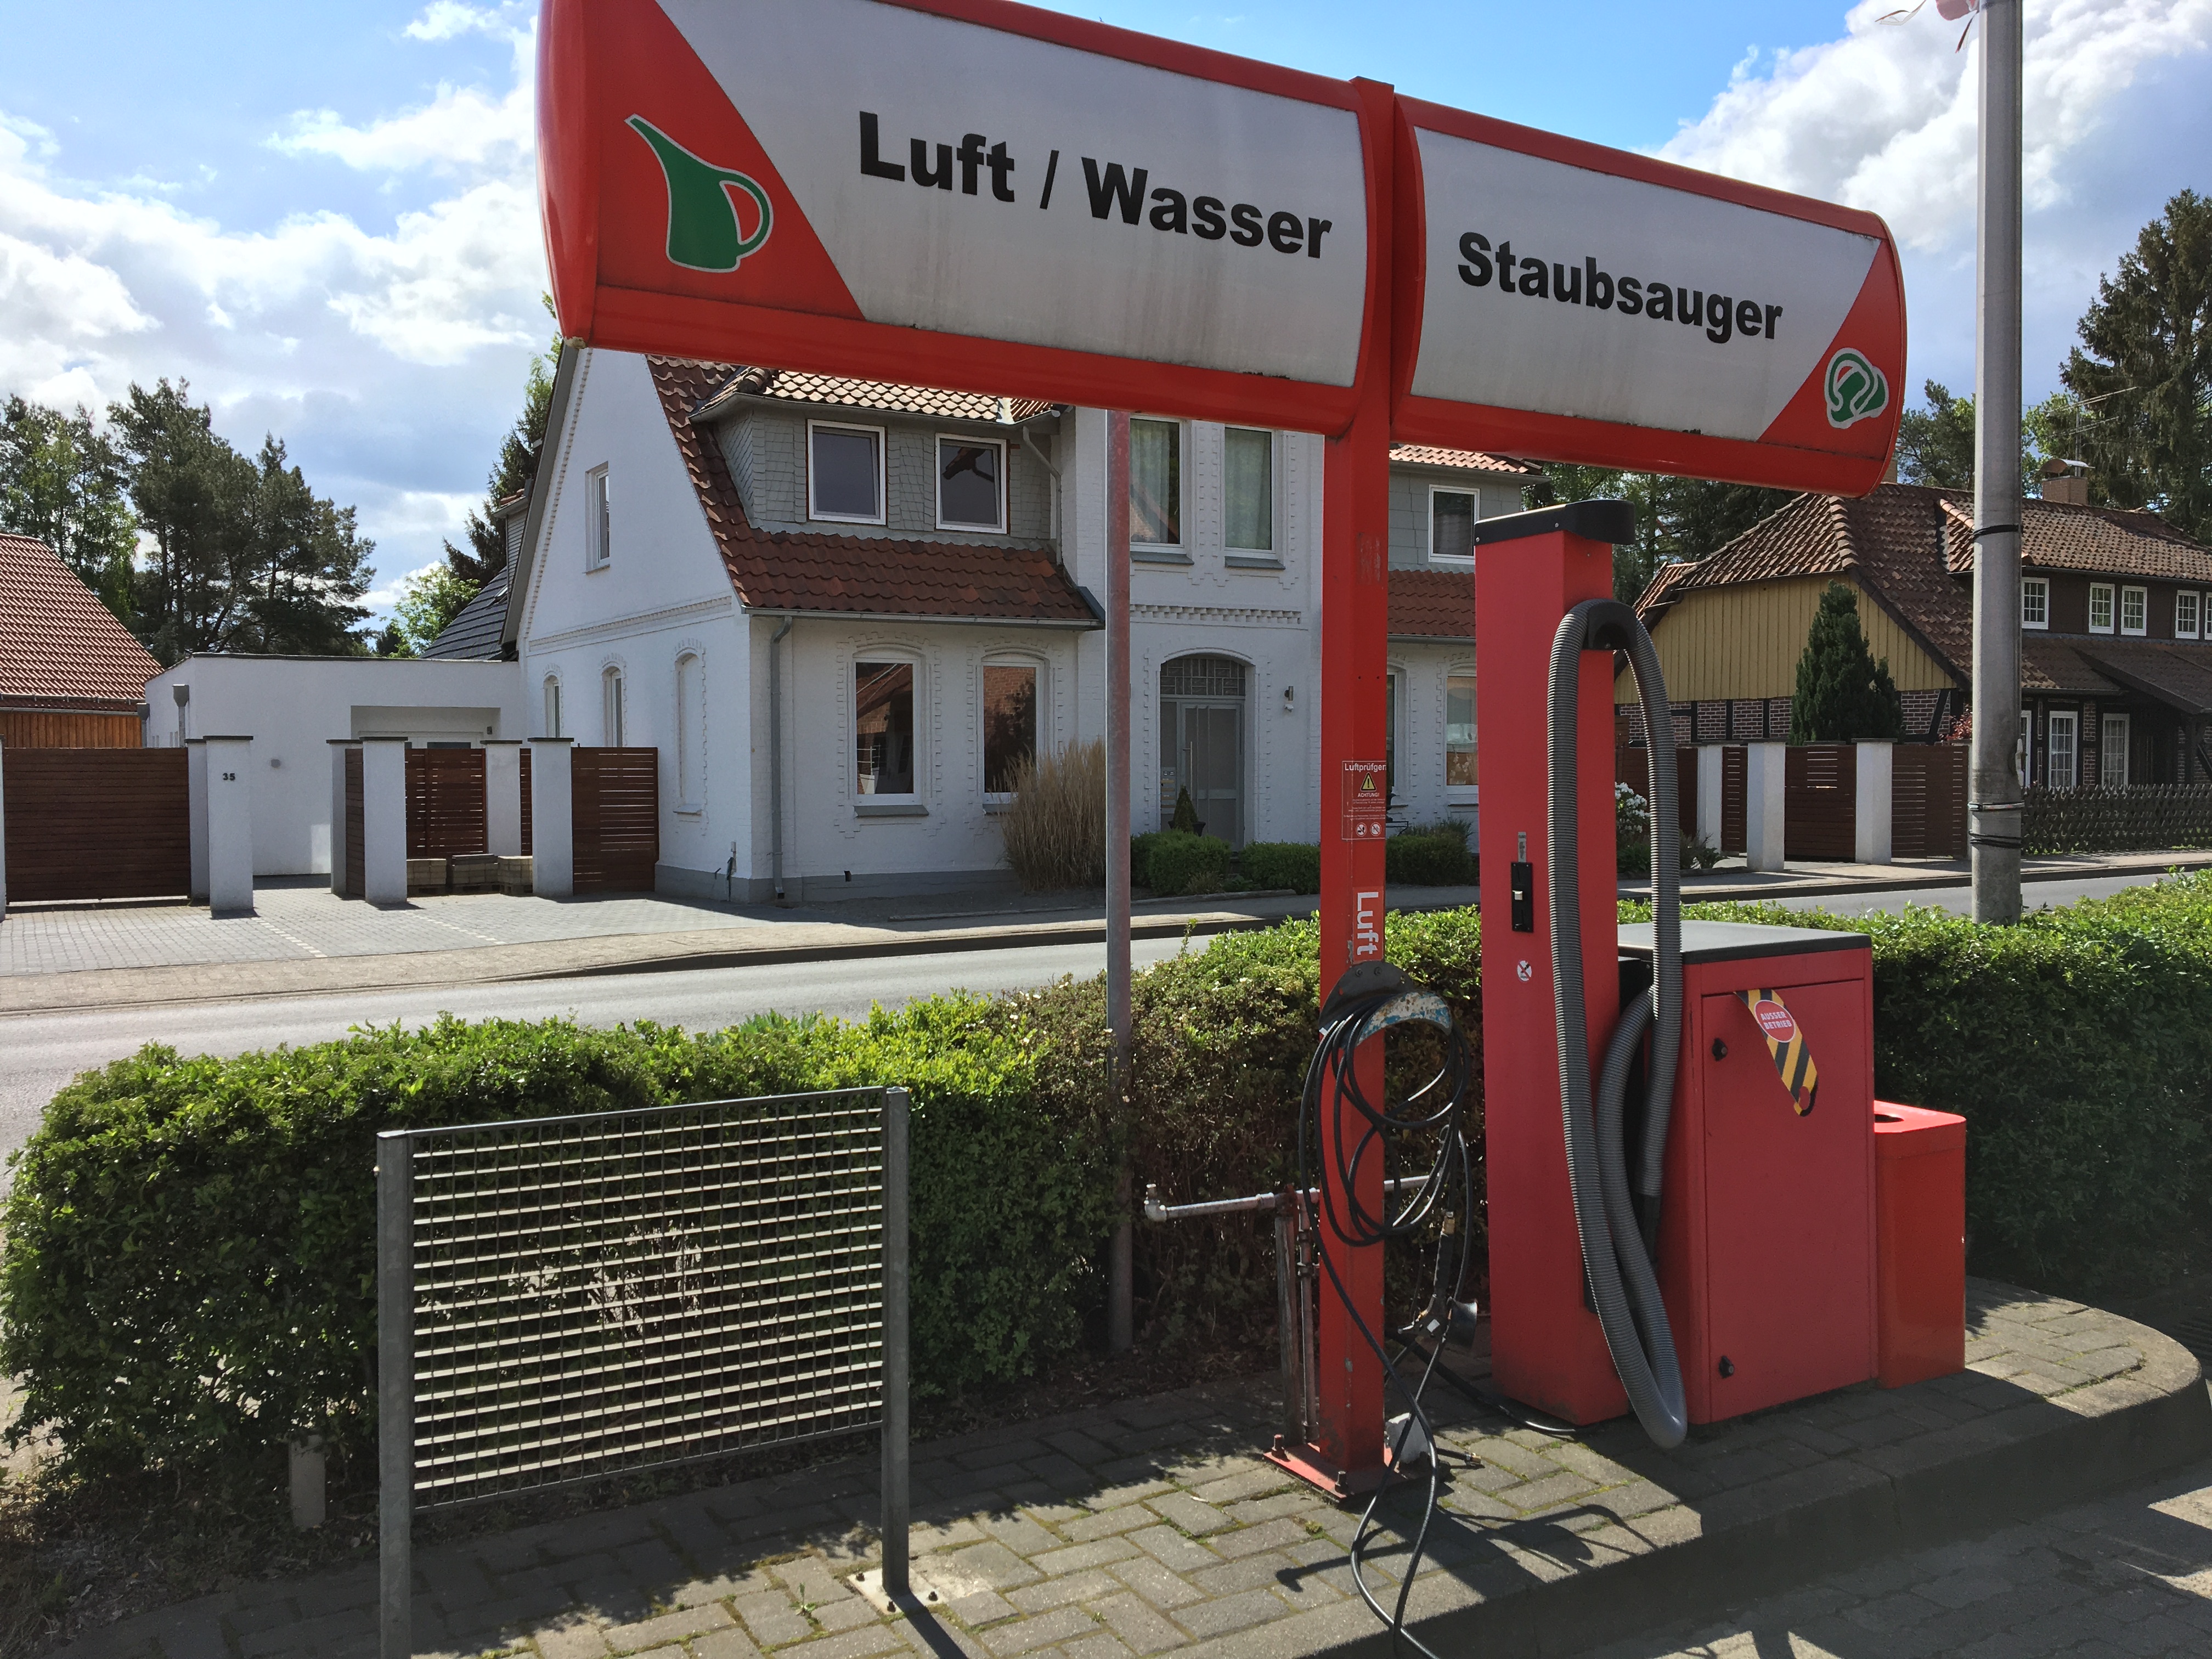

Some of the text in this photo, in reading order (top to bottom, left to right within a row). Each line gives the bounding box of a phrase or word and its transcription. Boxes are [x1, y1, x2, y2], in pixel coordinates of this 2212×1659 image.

[859, 110, 1333, 259] Luft / Wasser
[1457, 232, 1784, 344] Staubsauger
[1345, 763, 1387, 772] Luftprüfger
[222, 772, 236, 781] 35
[1357, 891, 1379, 956] Luft
[1760, 1011, 1787, 1020] AUSSER
[1763, 1020, 1792, 1030] BETRIEB
